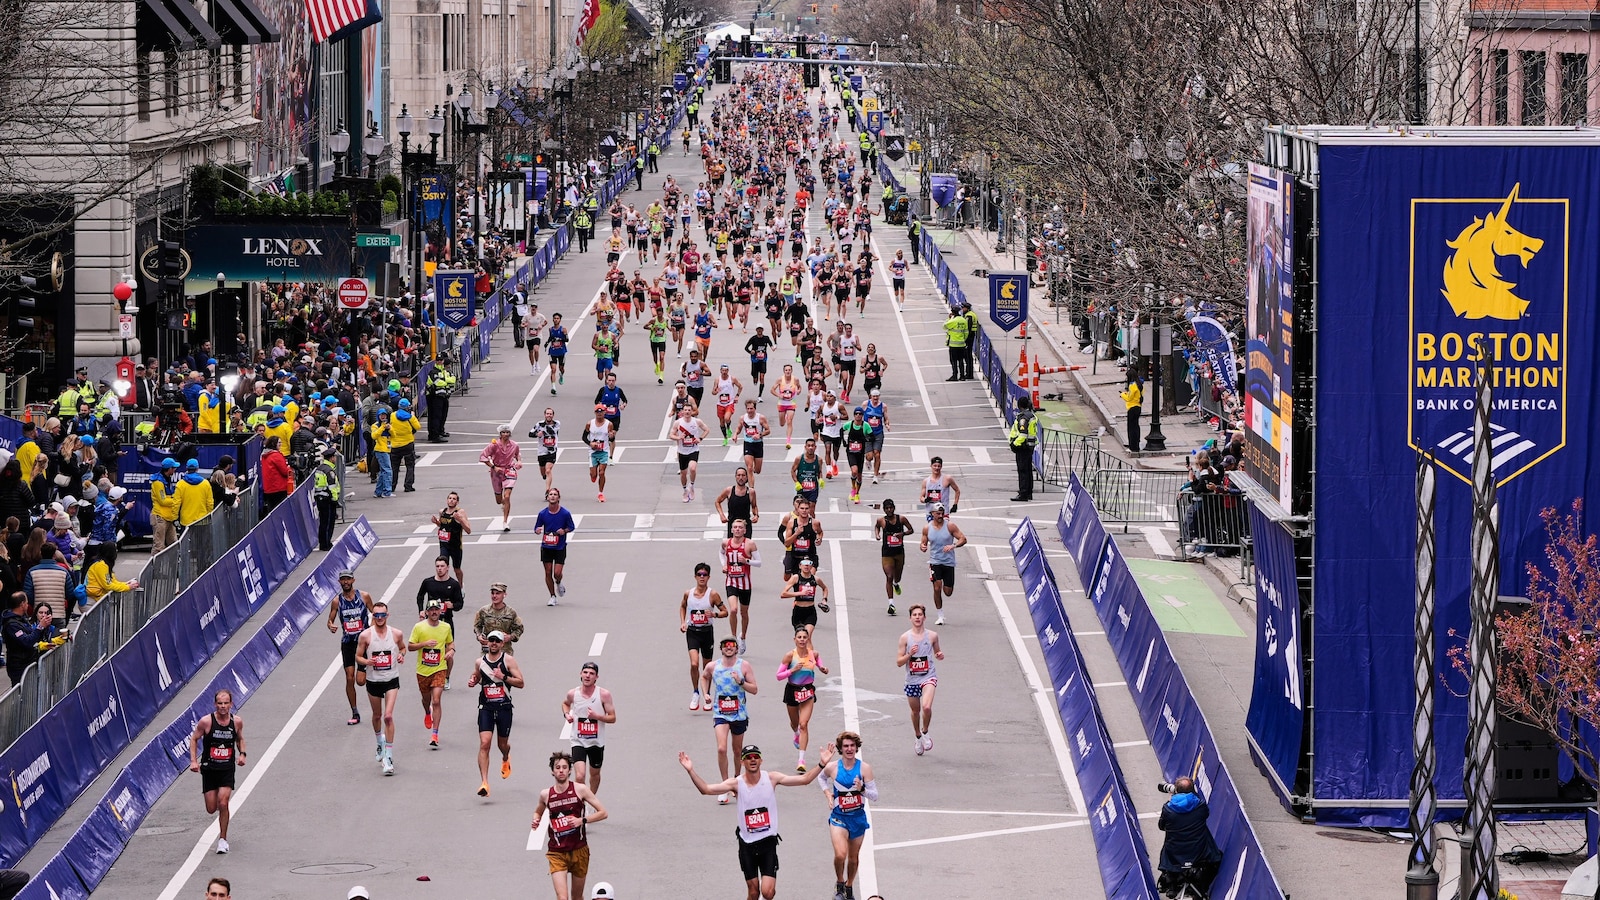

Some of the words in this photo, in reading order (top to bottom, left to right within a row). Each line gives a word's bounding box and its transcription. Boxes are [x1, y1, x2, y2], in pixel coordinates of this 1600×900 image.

[366, 237, 391, 246] EXETER
[266, 257, 300, 268] HOTEL
[1417, 332, 1559, 361] BOSTON
[1416, 399, 1459, 410] BANK
[841, 795, 859, 805] 2504
[748, 814, 766, 825] 5241
